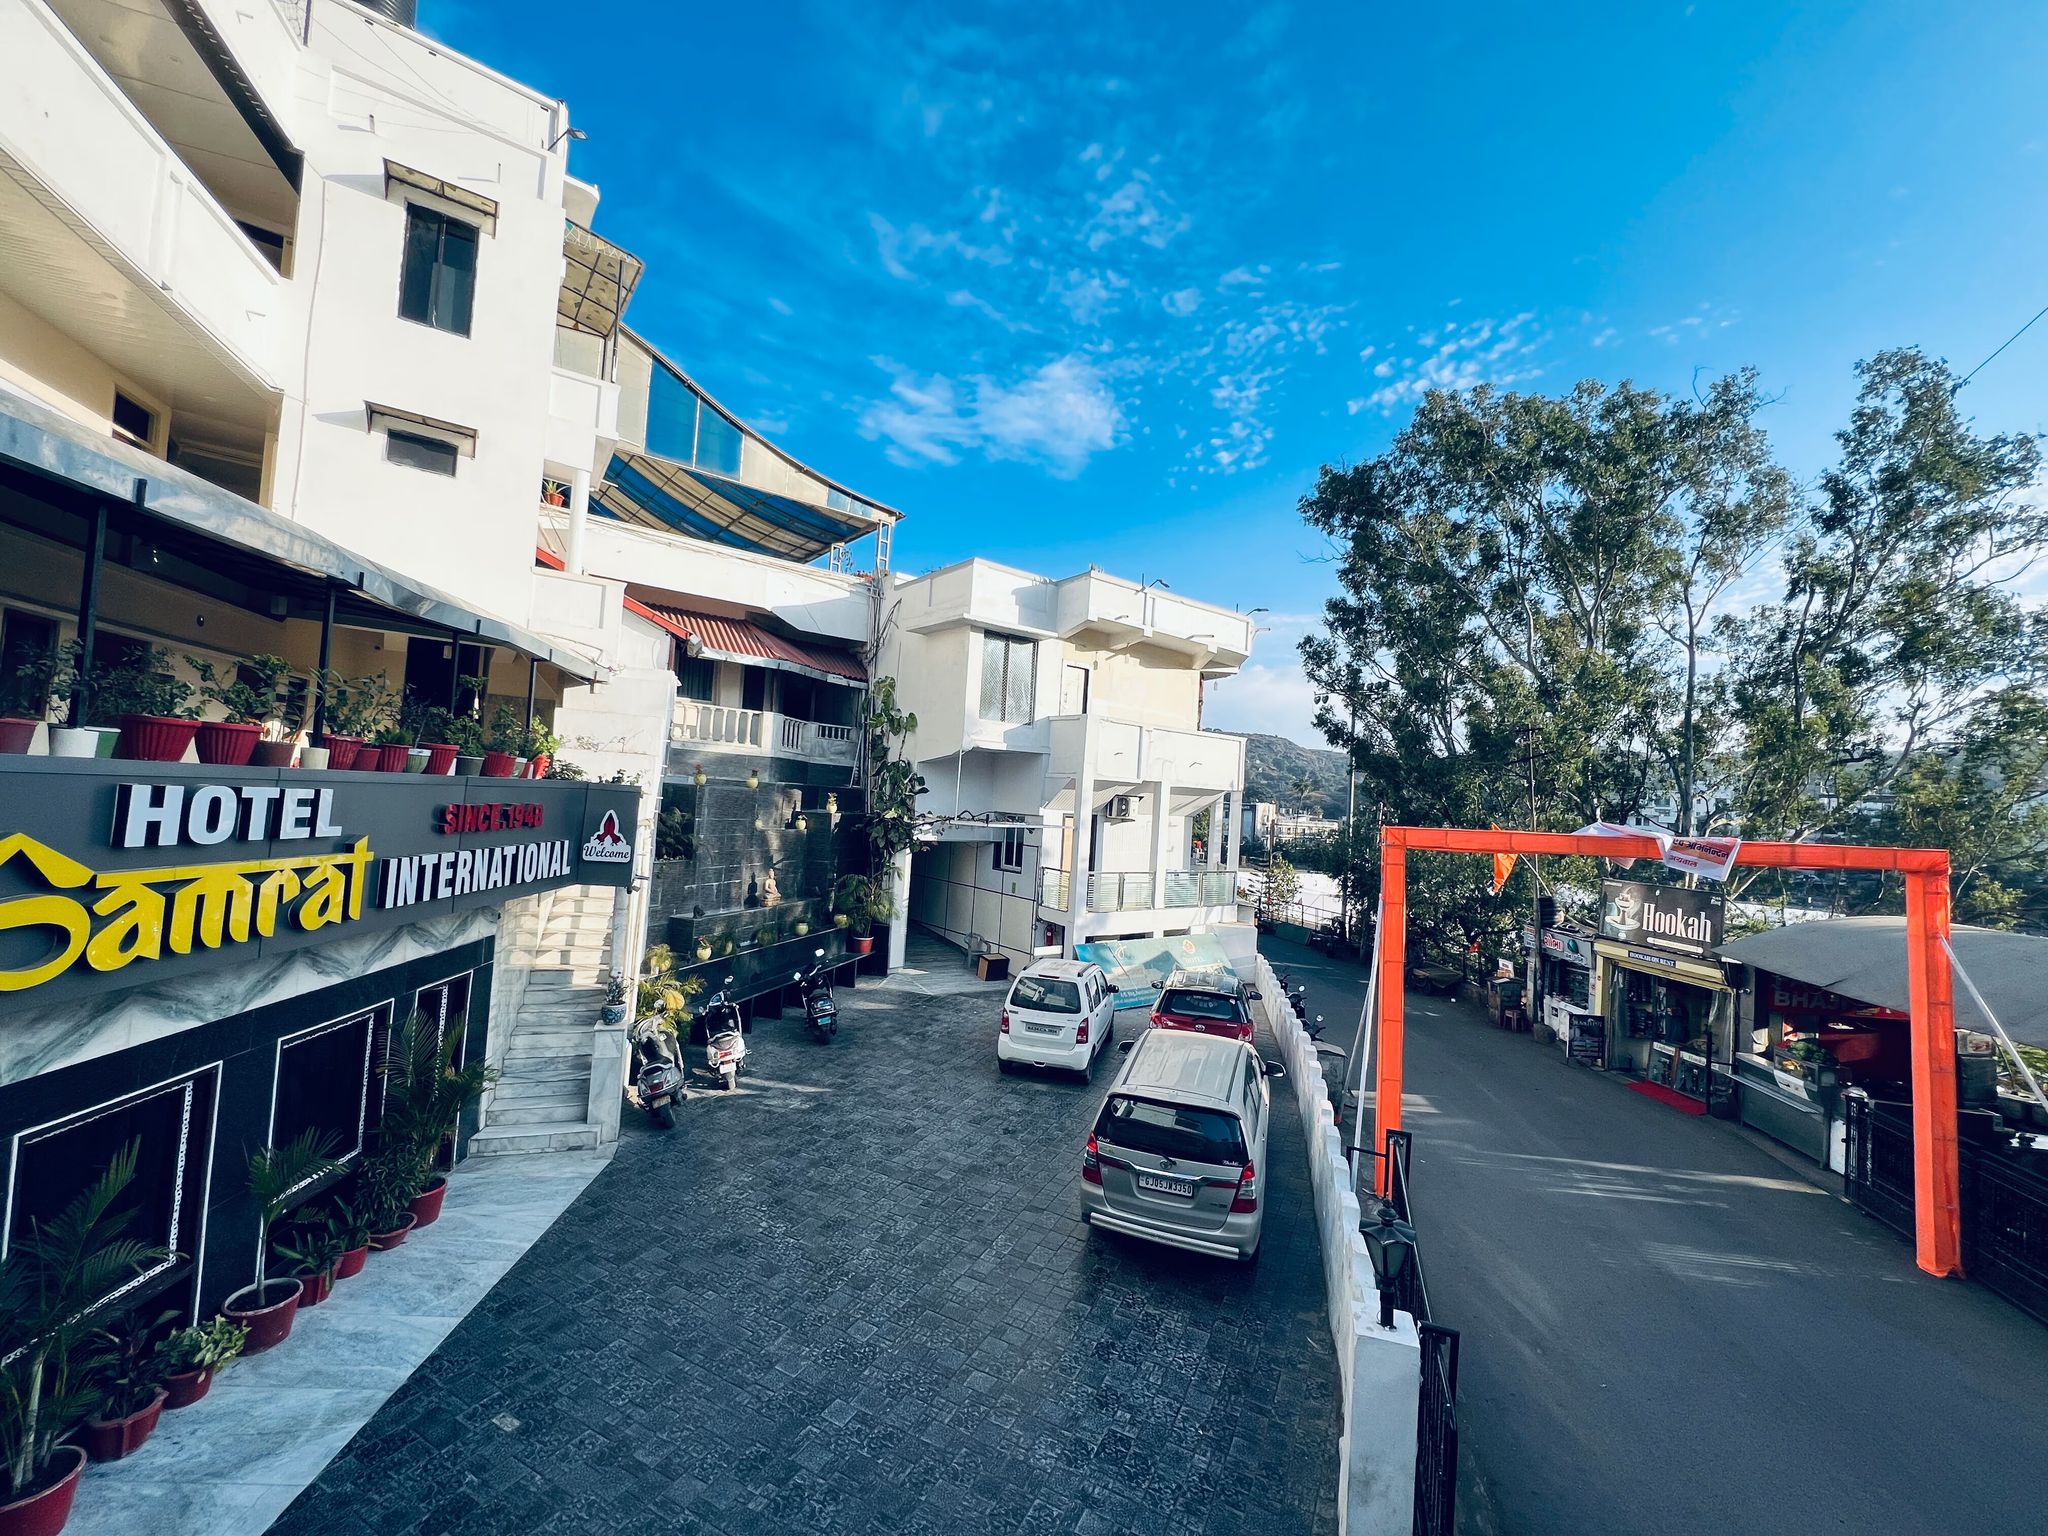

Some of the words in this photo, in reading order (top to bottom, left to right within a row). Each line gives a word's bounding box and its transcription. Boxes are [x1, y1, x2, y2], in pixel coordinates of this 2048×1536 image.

[120, 783, 343, 848] HOTEL
[583, 845, 630, 859] Welcome
[384, 839, 571, 909] INTERNATIONAL
[1641, 902, 1712, 943] Hookah
[1629, 951, 1651, 962] HOOKAH
[1660, 958, 1675, 967] RENT
